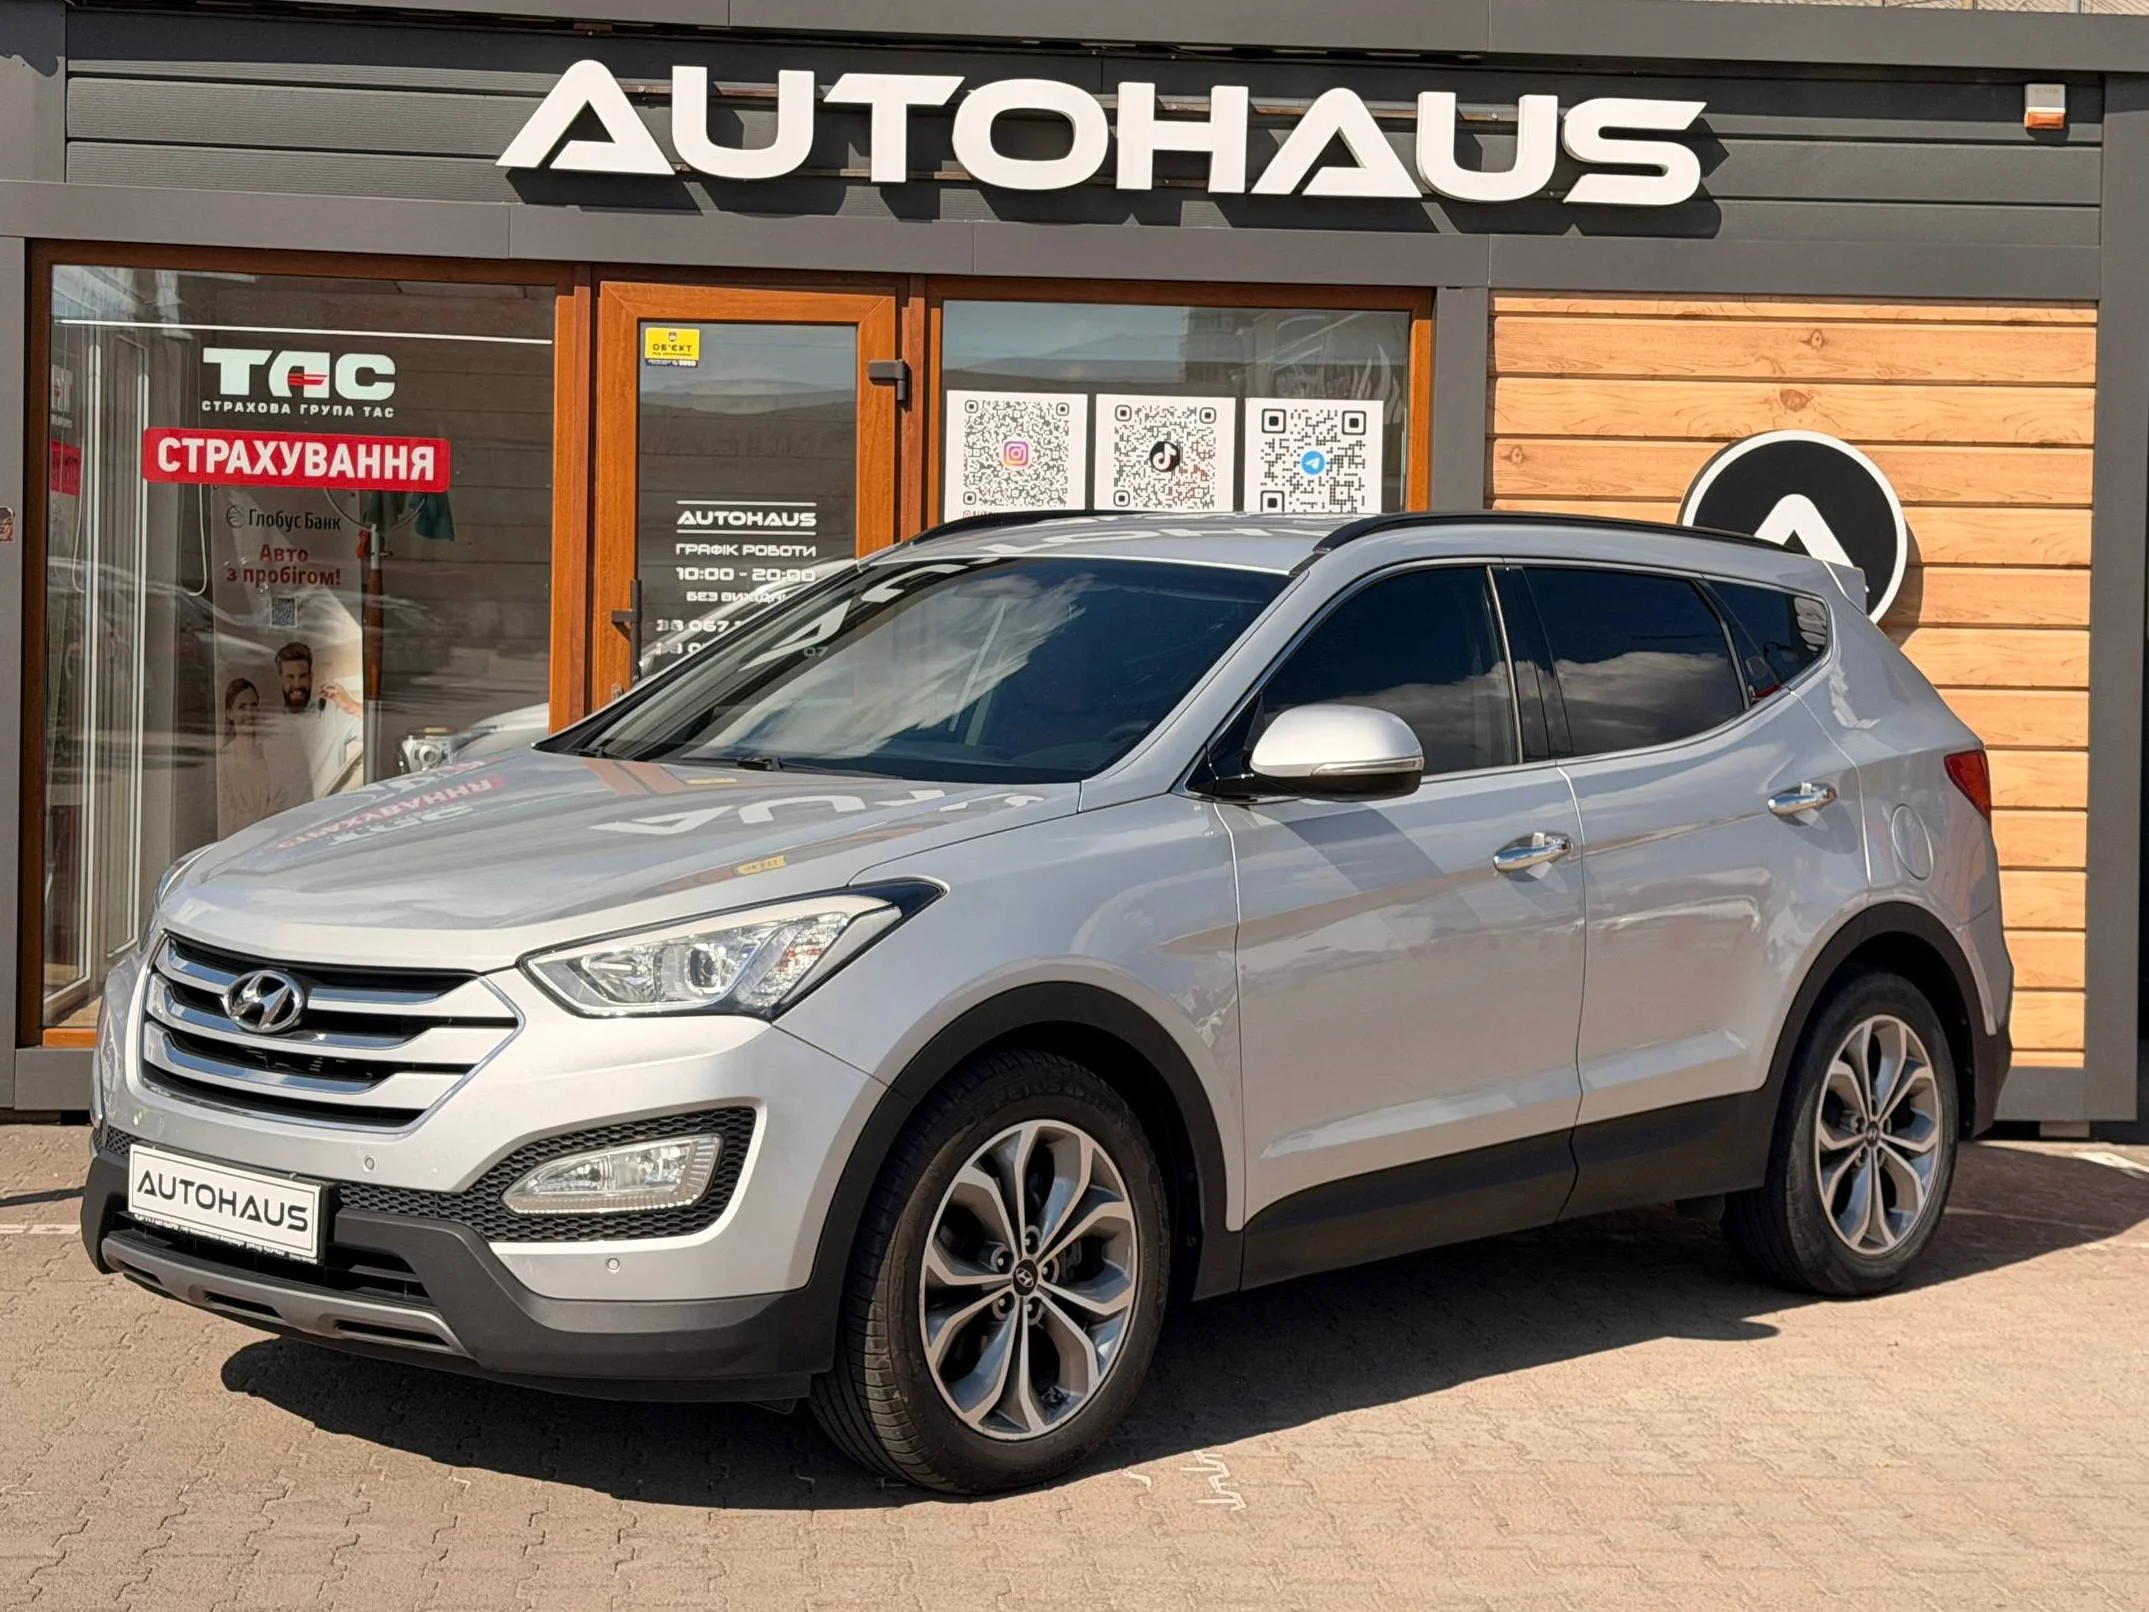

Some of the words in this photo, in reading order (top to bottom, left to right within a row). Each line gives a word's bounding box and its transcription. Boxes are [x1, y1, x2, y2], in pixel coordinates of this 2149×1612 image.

[496, 59, 1706, 206] AUTOHAUS
[202, 401, 291, 414] СТРАХОВА
[300, 404, 354, 416] ГРУПА
[363, 406, 395, 417] ТАС
[158, 437, 435, 481] СТРАХУВАННЯ
[249, 509, 301, 532] Глобус
[305, 512, 341, 530] Банк
[677, 511, 817, 526] AUTOHAUS
[260, 544, 309, 561] Авто
[676, 543, 739, 556] ГРАФІК
[742, 545, 816, 557] РОБОТИ
[226, 567, 237, 582] з
[243, 566, 341, 588] пробігом!
[676, 567, 734, 581] 10:00
[752, 568, 816, 582] 20:00
[686, 591, 718, 602] БЕЗ
[688, 619, 729, 633] 067
[137, 1169, 308, 1232] AUTOHAUS
